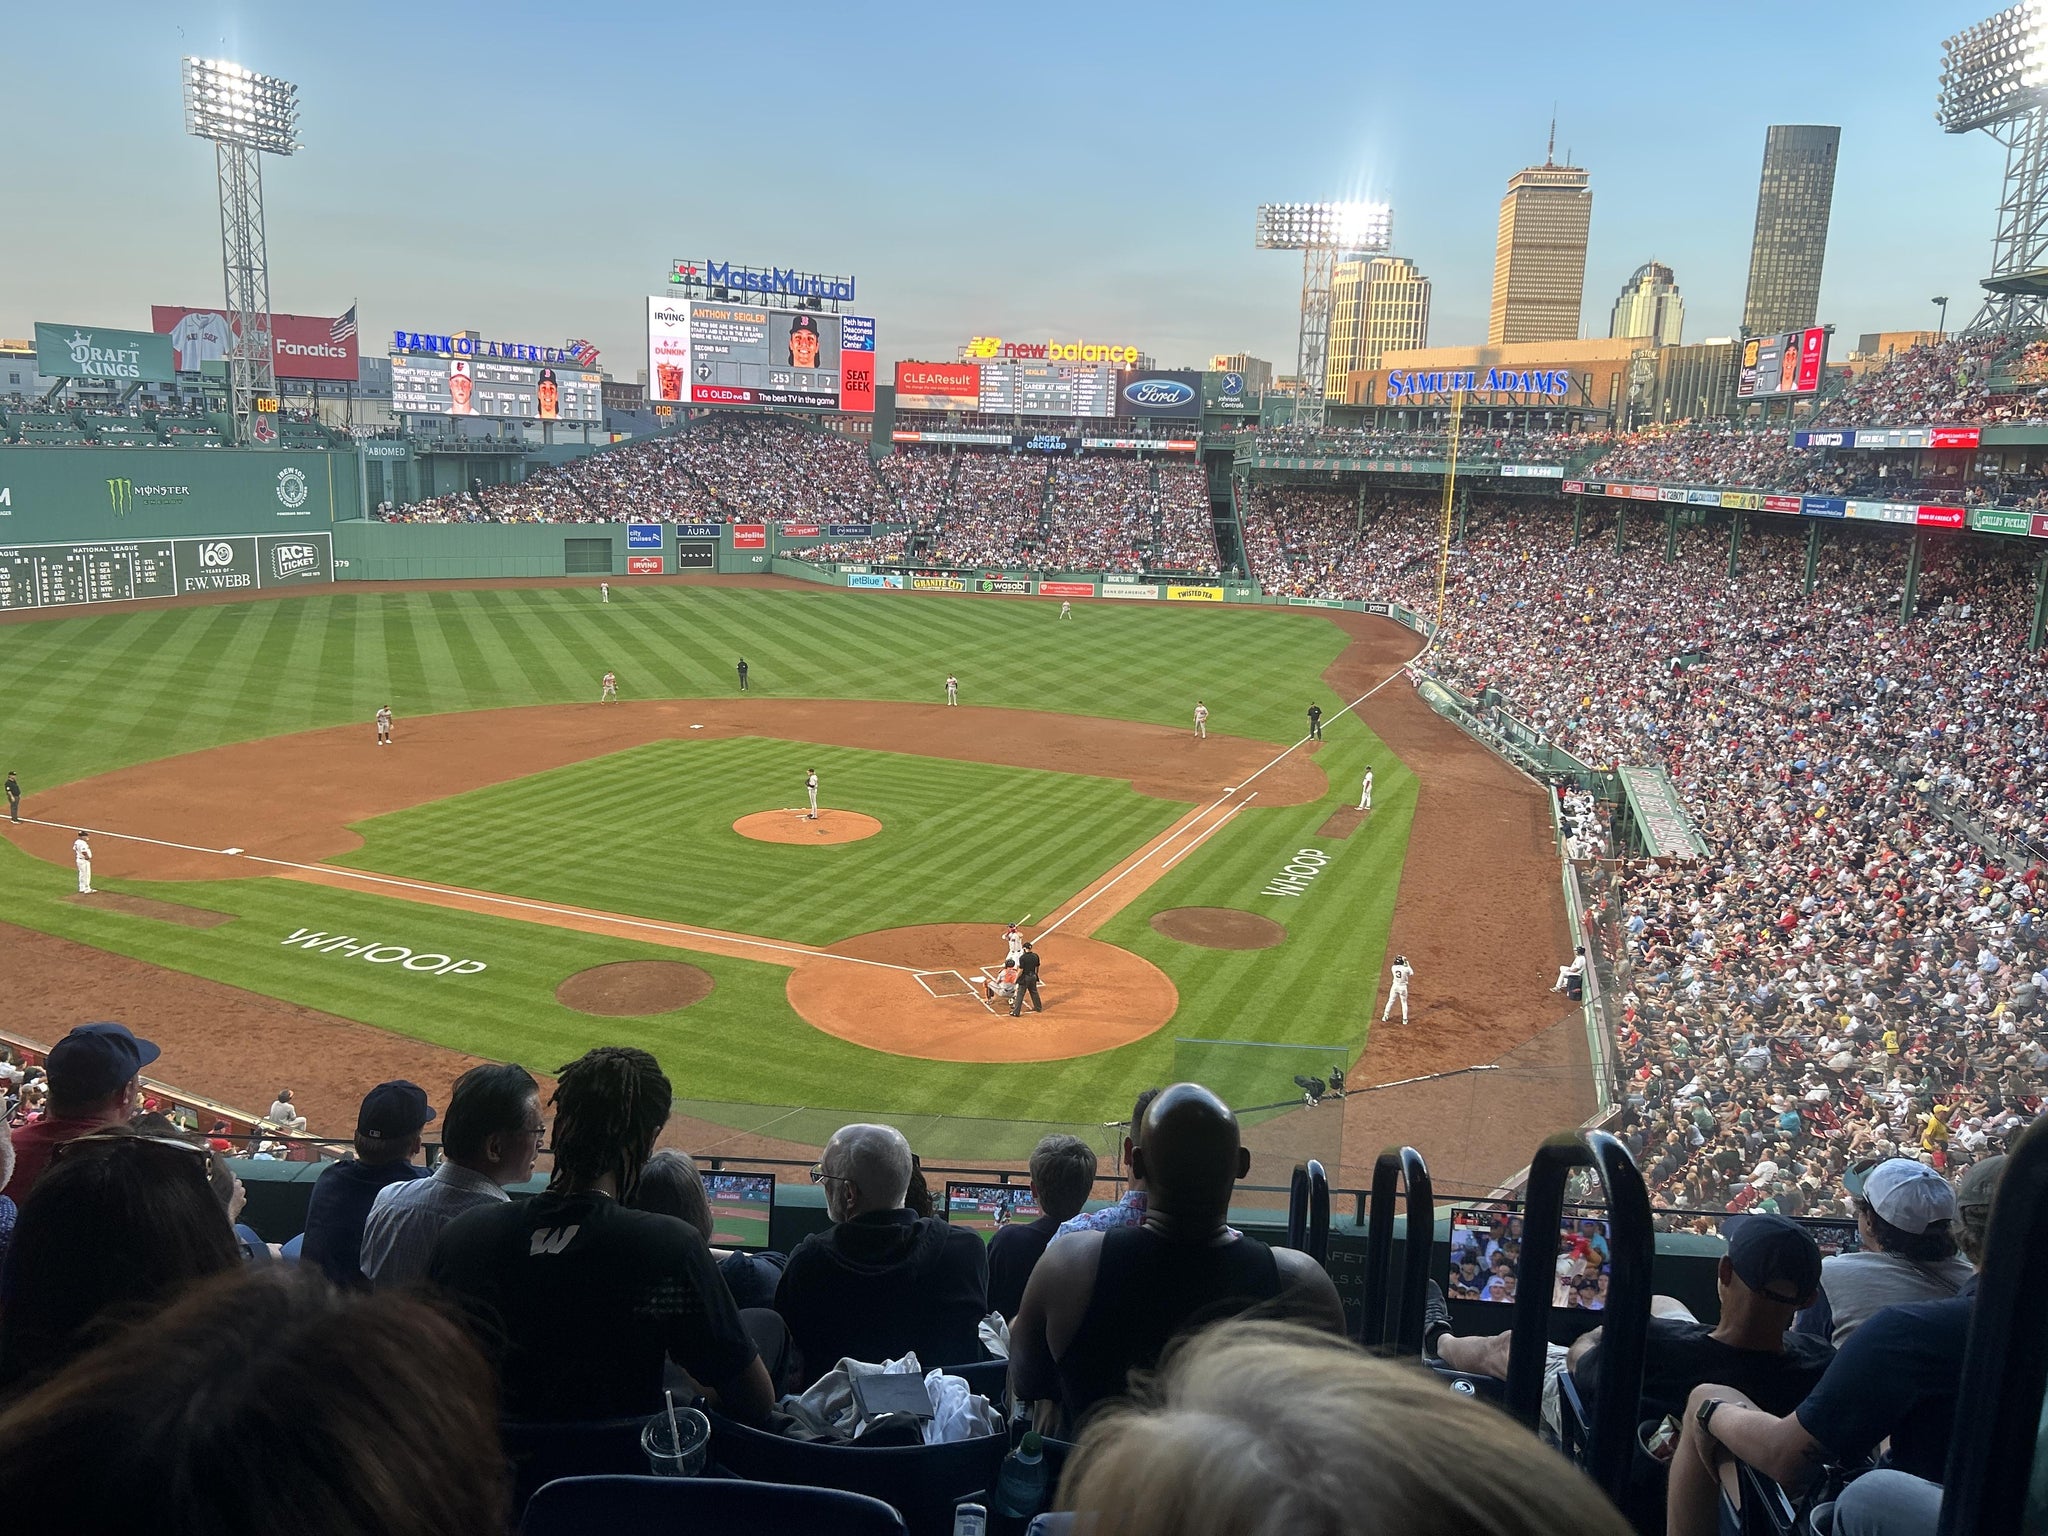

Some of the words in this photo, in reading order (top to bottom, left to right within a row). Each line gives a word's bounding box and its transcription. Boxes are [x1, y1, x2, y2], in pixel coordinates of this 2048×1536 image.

[705, 260, 856, 301] MassMutual
[654, 312, 685, 322] IRVING
[692, 308, 731, 320] ANTHONY
[734, 312, 766, 323] SEIGLER
[843, 326, 872, 335] Deaconess
[276, 338, 347, 358] Fanatics
[394, 331, 452, 354] BANK
[458, 337, 482, 356] OF
[488, 341, 566, 363] AMERICA
[843, 341, 862, 349] Center
[1004, 342, 1046, 358] new
[1049, 338, 1138, 363] balance
[70, 344, 140, 364] DRAFT
[392, 358, 407, 366] BAZ
[81, 361, 140, 378] KINGS
[698, 367, 709, 377] F7
[846, 369, 870, 381] SEAT
[770, 374, 790, 384] .253
[802, 376, 807, 384] 2
[826, 377, 830, 386] 7
[903, 373, 970, 385] CLEAResult
[1387, 369, 1479, 398] SAMUEL
[1482, 366, 1570, 396] ADAMS
[846, 380, 870, 392] GEEK
[696, 389, 708, 398] LG
[710, 390, 733, 400] OLED
[758, 392, 772, 402] The
[772, 394, 788, 403] best
[788, 394, 798, 403] TV
[798, 396, 805, 404] in
[804, 396, 816, 404] the
[816, 398, 835, 406] game
[1137, 384, 1180, 403] Ford
[503, 402, 510, 414] 2
[1027, 441, 1067, 450] ORCHARD
[1033, 435, 1061, 444] ANGRY
[368, 448, 406, 456] ABIOMED
[1312, 460, 1326, 469] 27
[277, 467, 294, 480] IBEW
[134, 485, 190, 496] MONSTER
[798, 527, 818, 535] TICKET
[198, 542, 234, 567] 160
[280, 544, 314, 562] ACE
[282, 558, 314, 572] TICKET
[334, 560, 350, 568] 379
[184, 576, 210, 591] F.W.
[211, 574, 251, 588] WEBB
[851, 576, 880, 586] jetBlue
[914, 579, 946, 588] GRANITE
[948, 580, 964, 590] CITY
[994, 582, 1026, 590] wasabi
[1178, 590, 1202, 598] TWISTED
[1202, 591, 1212, 599] TEA
[1260, 848, 1332, 896] WHOOP
[280, 928, 488, 976] WHOOP
[1395, 970, 1402, 978] 3
[1016, 1206, 1040, 1214] Safelite
[530, 1224, 580, 1256] W
